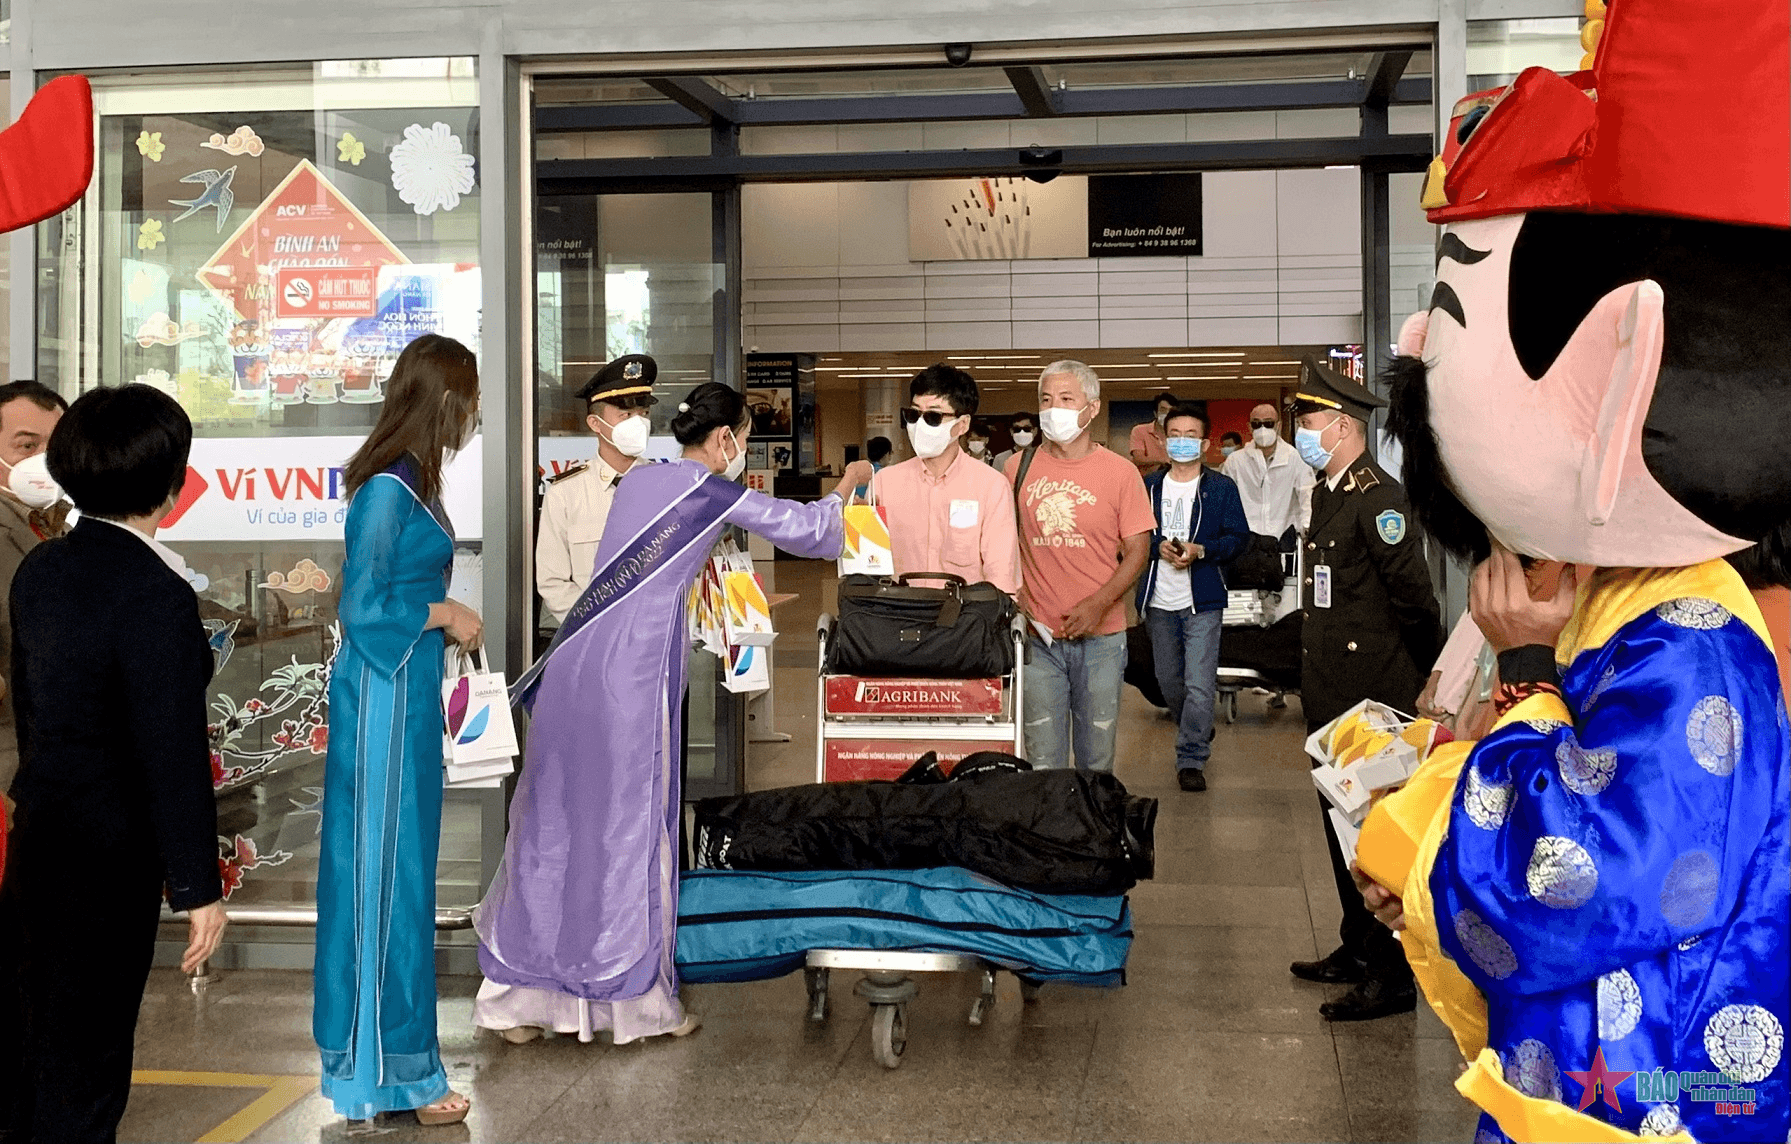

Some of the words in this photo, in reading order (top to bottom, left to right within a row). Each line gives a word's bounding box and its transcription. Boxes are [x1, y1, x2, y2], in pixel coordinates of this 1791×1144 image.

[276, 204, 307, 217] ACV
[1103, 228, 1122, 238] Bạn
[1124, 227, 1145, 237] luôn
[274, 233, 315, 253] BÌNH
[316, 235, 340, 253] AN
[318, 301, 330, 310] NO
[332, 301, 371, 310] SMOKING
[215, 468, 257, 501] Ví
[264, 467, 347, 501] VNP
[1026, 476, 1097, 507] Heritage
[247, 508, 262, 524] Ví
[268, 507, 297, 524] của
[303, 508, 328, 528] gia
[1161, 498, 1195, 530] GA
[1065, 538, 1086, 548] 1849
[881, 690, 961, 703] AGRIBANK
